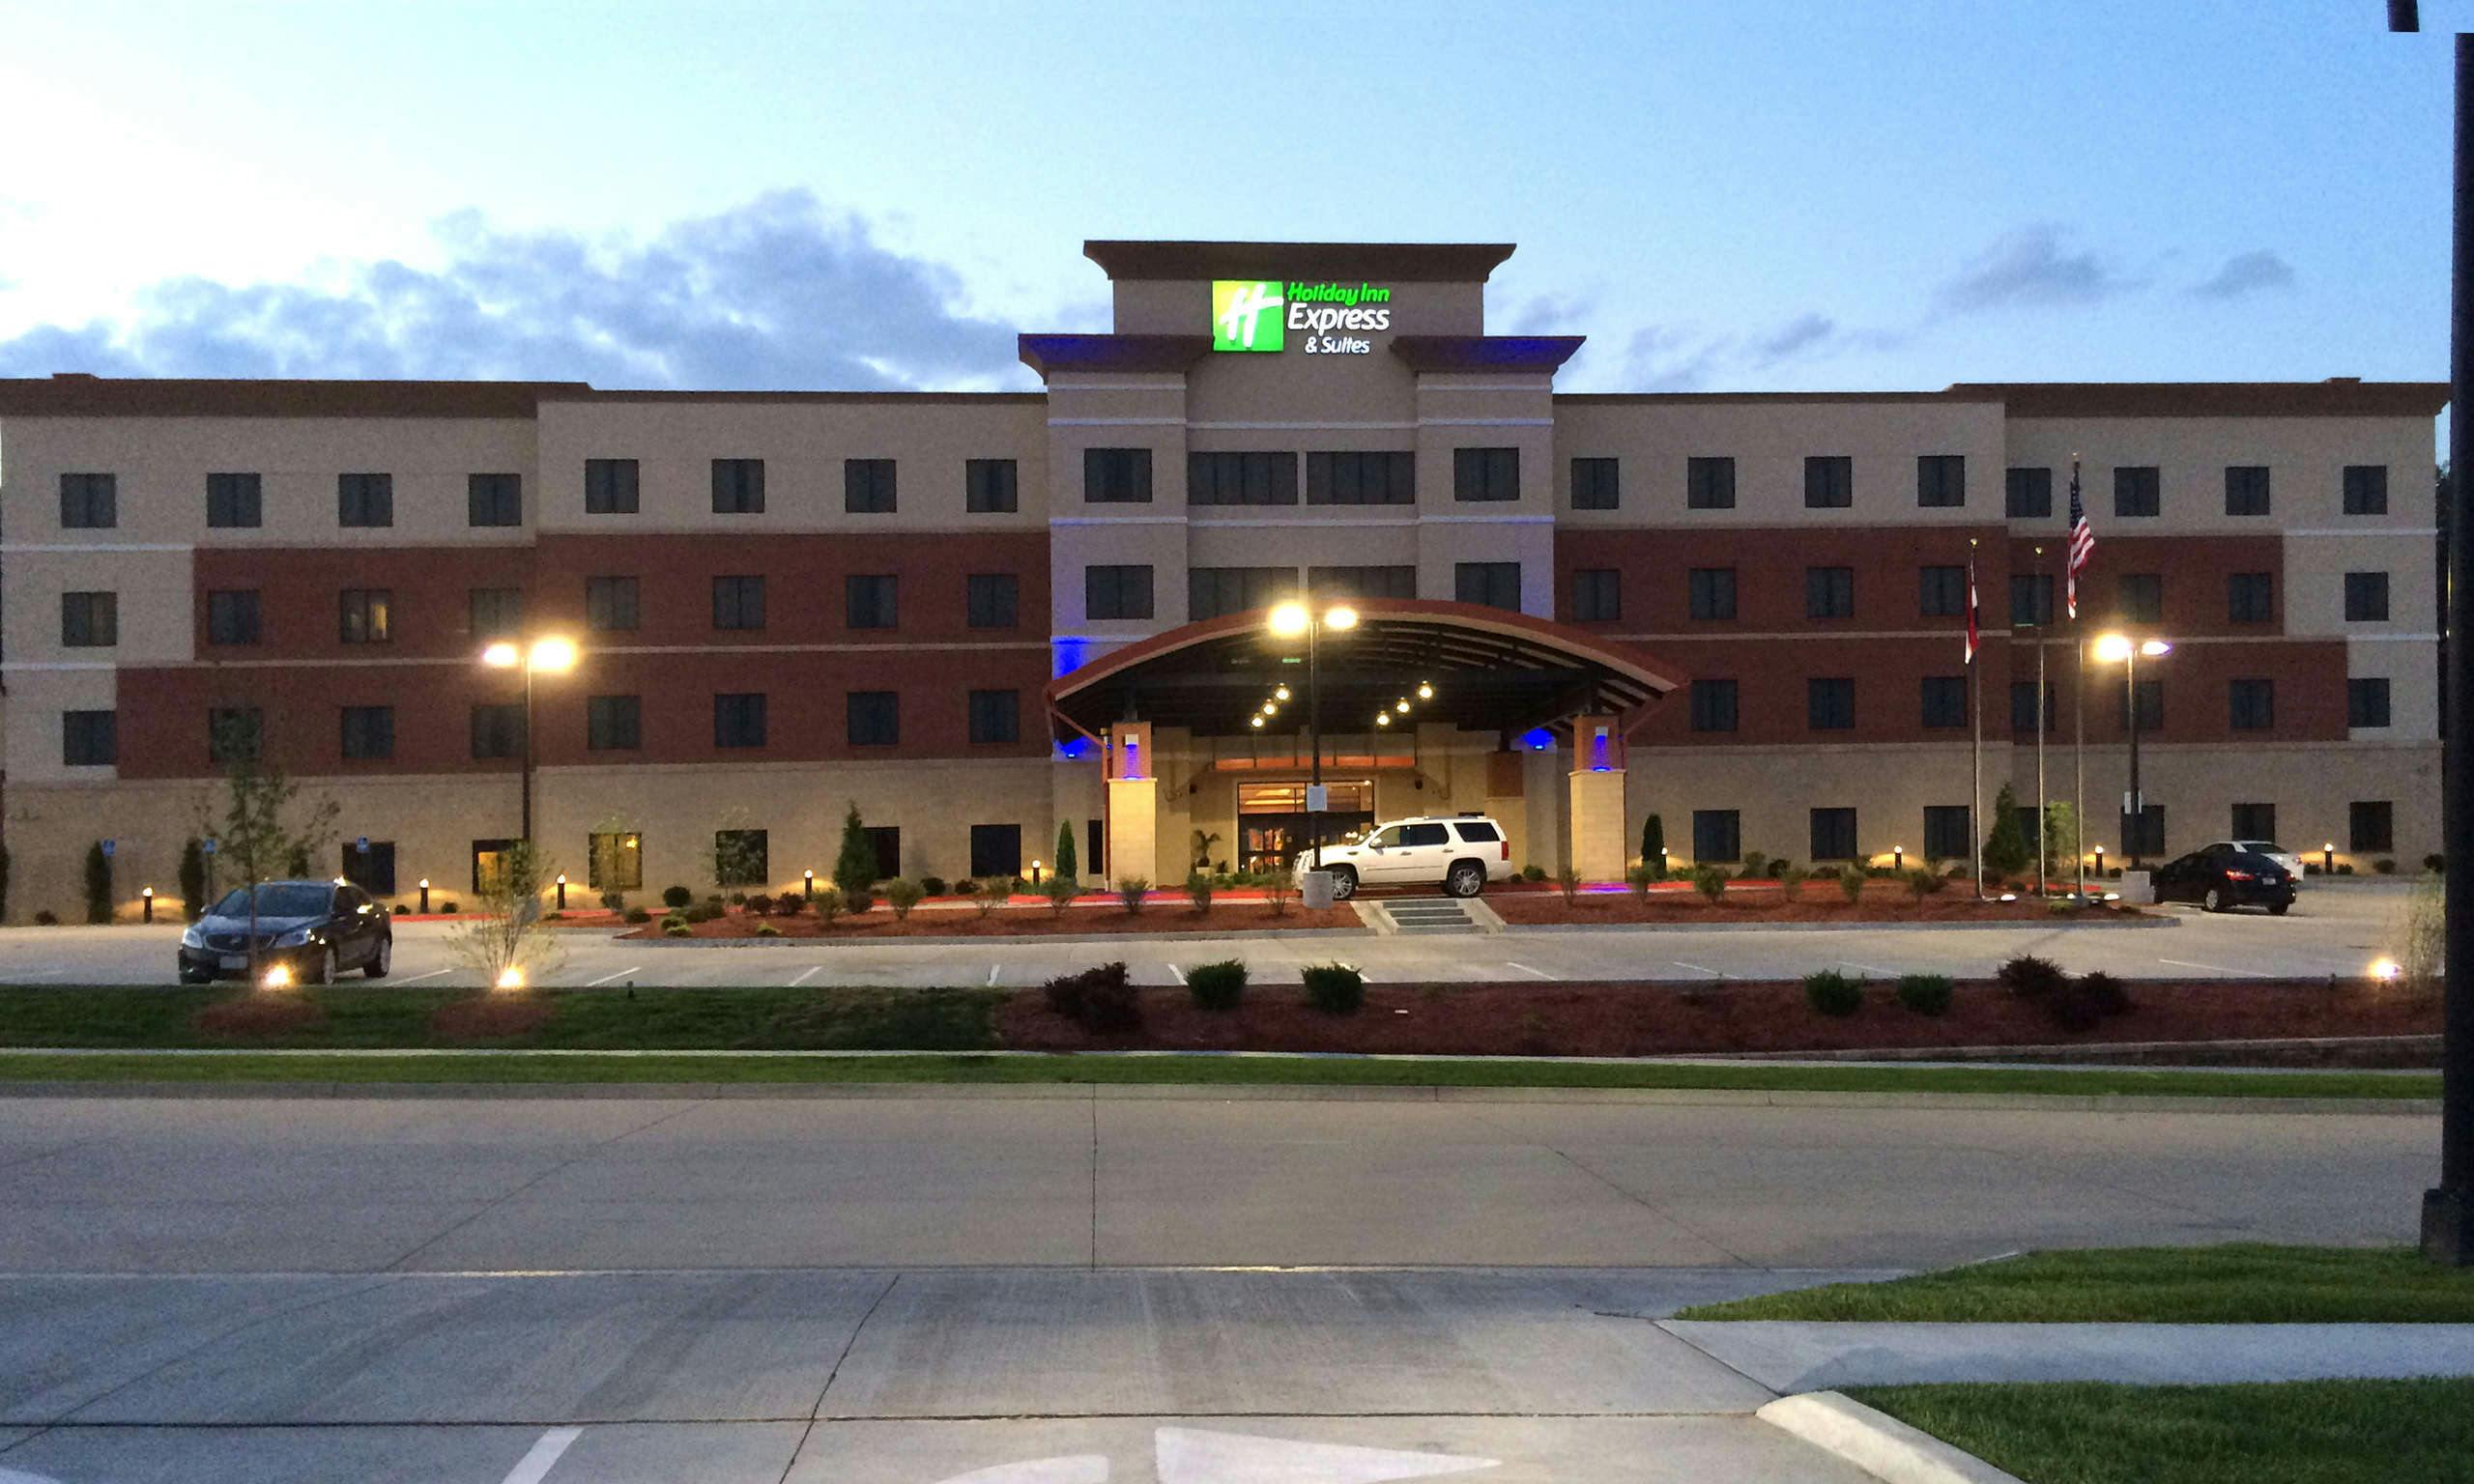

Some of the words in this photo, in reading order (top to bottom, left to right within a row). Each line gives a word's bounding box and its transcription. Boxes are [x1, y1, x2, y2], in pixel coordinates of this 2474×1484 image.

[1287, 281, 1359, 306] Holiday
[1361, 282, 1390, 302] Inn
[1287, 302, 1390, 336] Express
[1305, 336, 1318, 354] &
[1320, 336, 1370, 354] Suites
